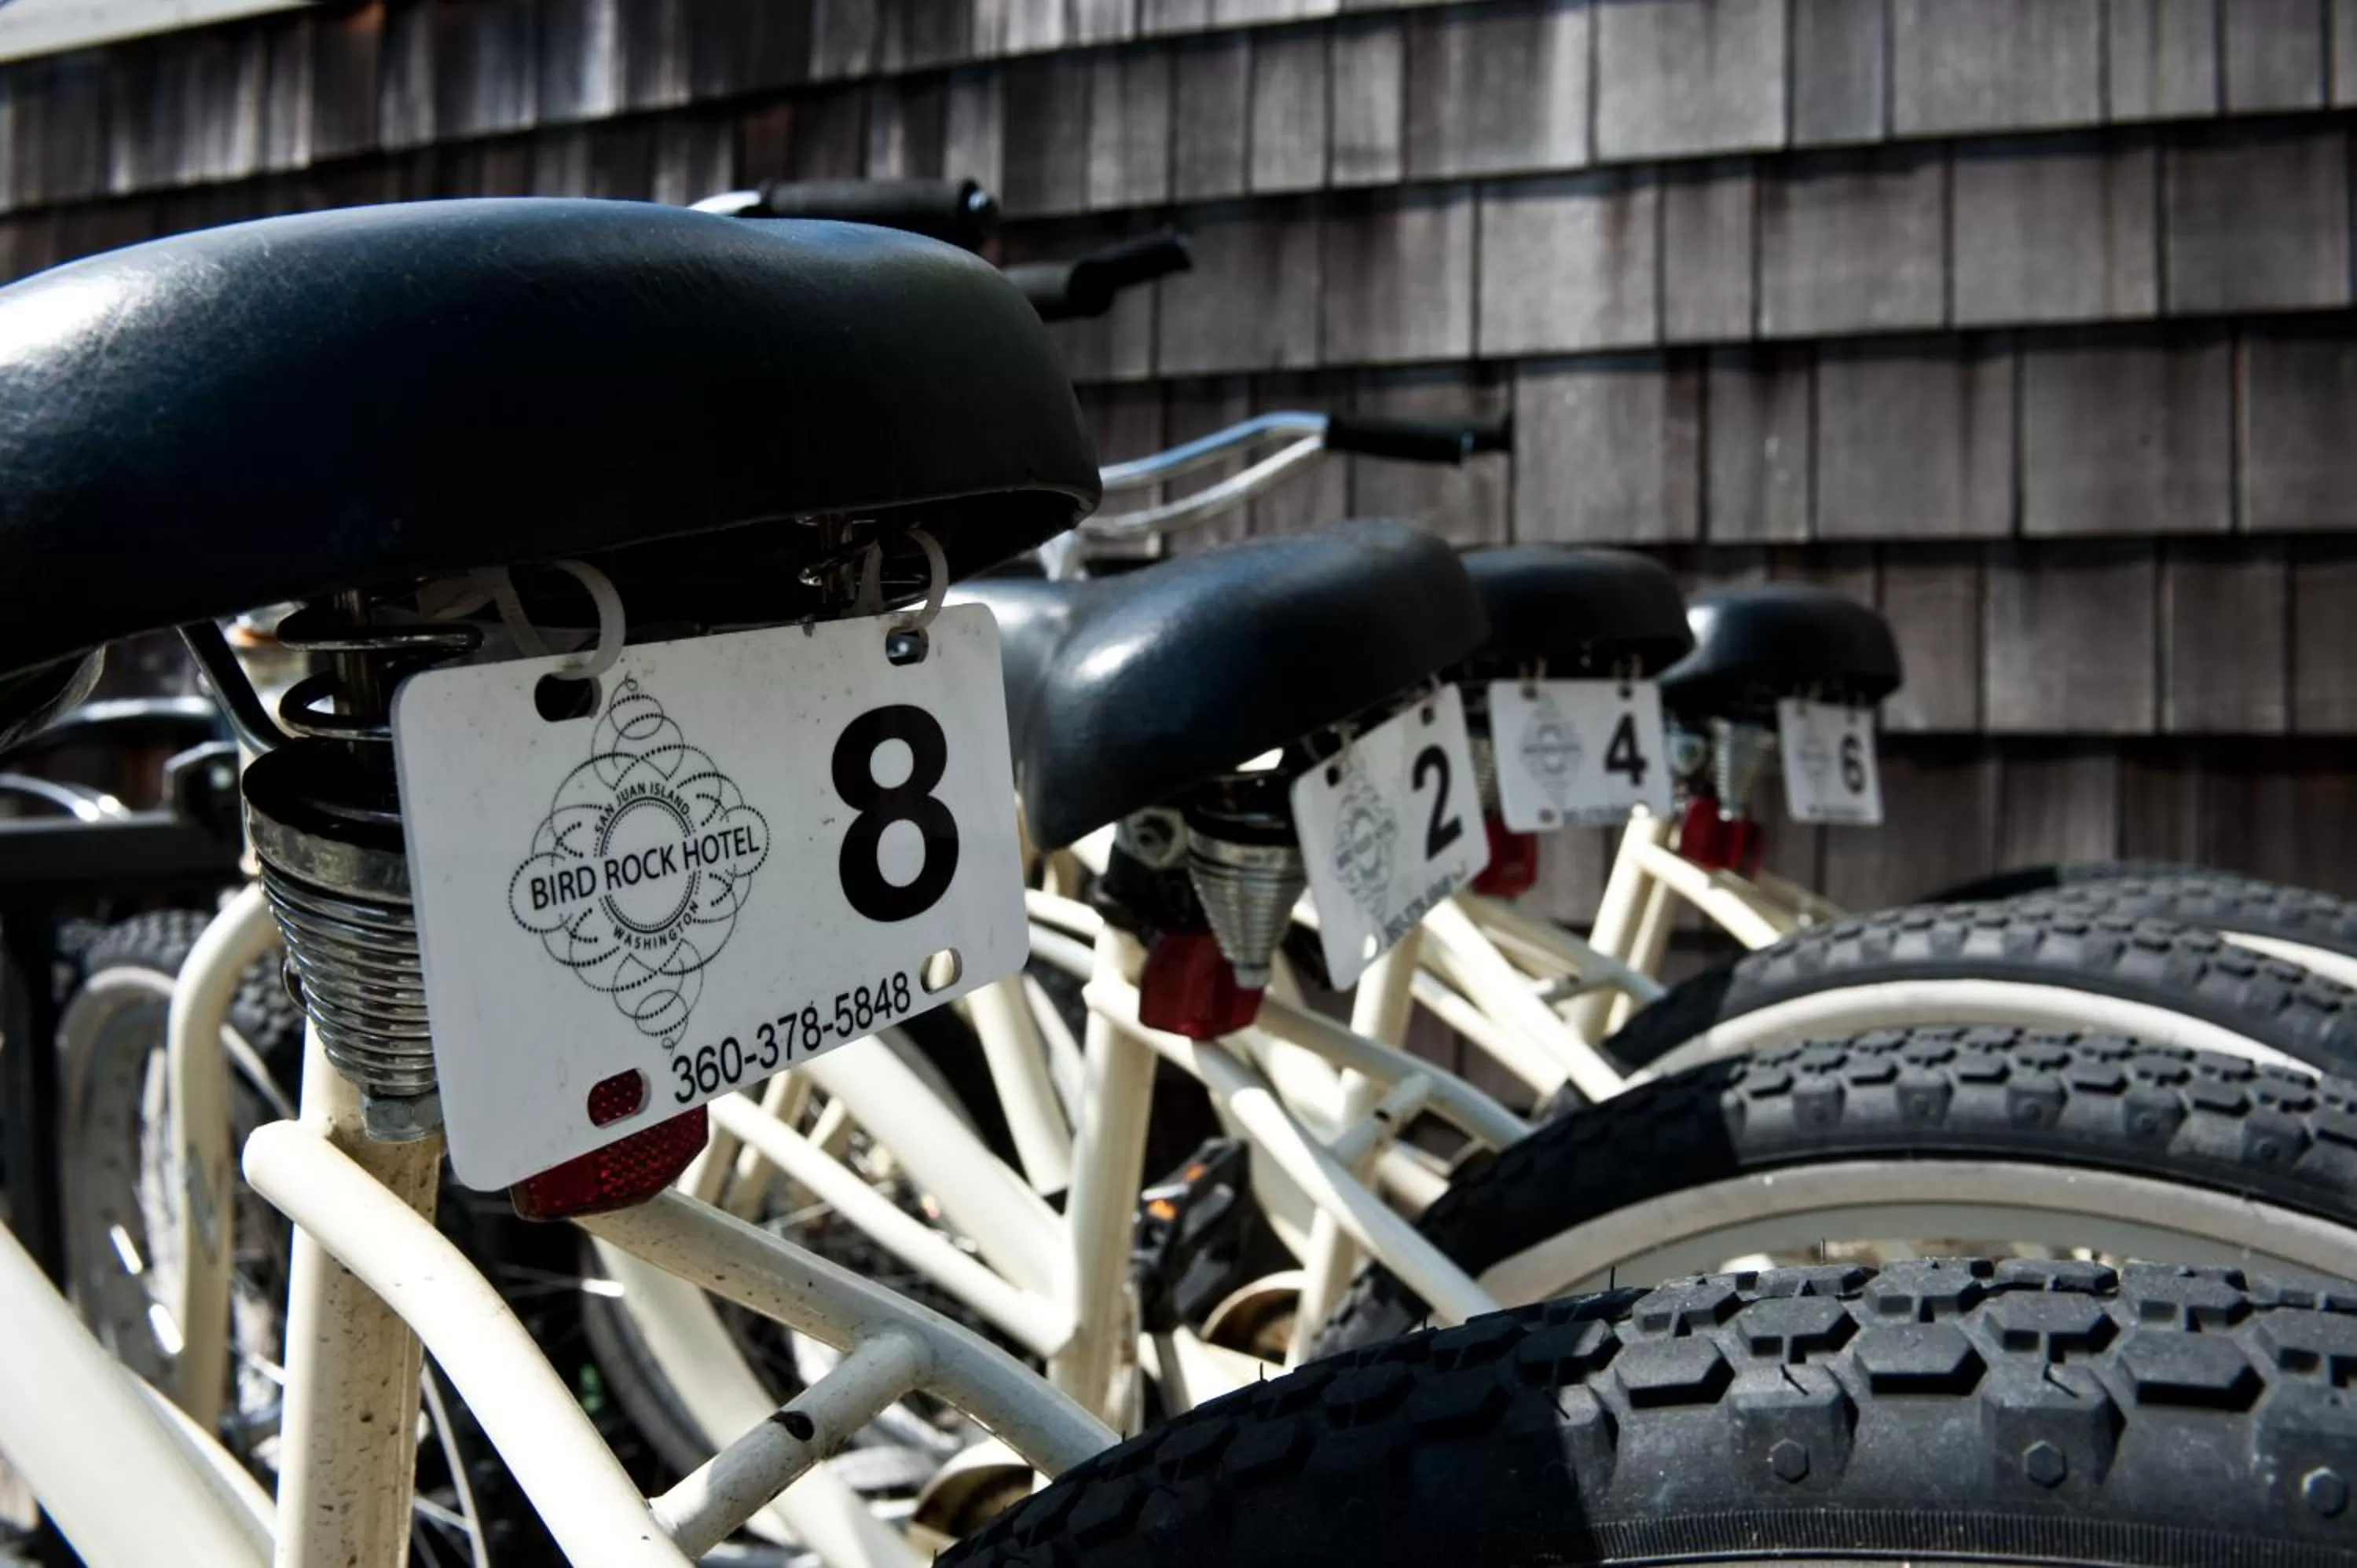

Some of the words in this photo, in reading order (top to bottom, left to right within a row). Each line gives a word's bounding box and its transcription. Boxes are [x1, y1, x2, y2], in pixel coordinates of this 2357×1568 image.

[1604, 713, 1648, 786] 4
[1839, 734, 1865, 795] 6
[594, 802, 614, 834] SAN
[614, 782, 647, 808] JUAN
[649, 782, 691, 815] ISLAND
[831, 703, 959, 922] 8
[1413, 744, 1464, 861] 2
[530, 866, 597, 910] BIRD
[603, 843, 676, 891] ROCK
[682, 825, 760, 870] HOTEL
[613, 902, 700, 951] WASHINGTON
[672, 971, 911, 1104] 360-378-5848
